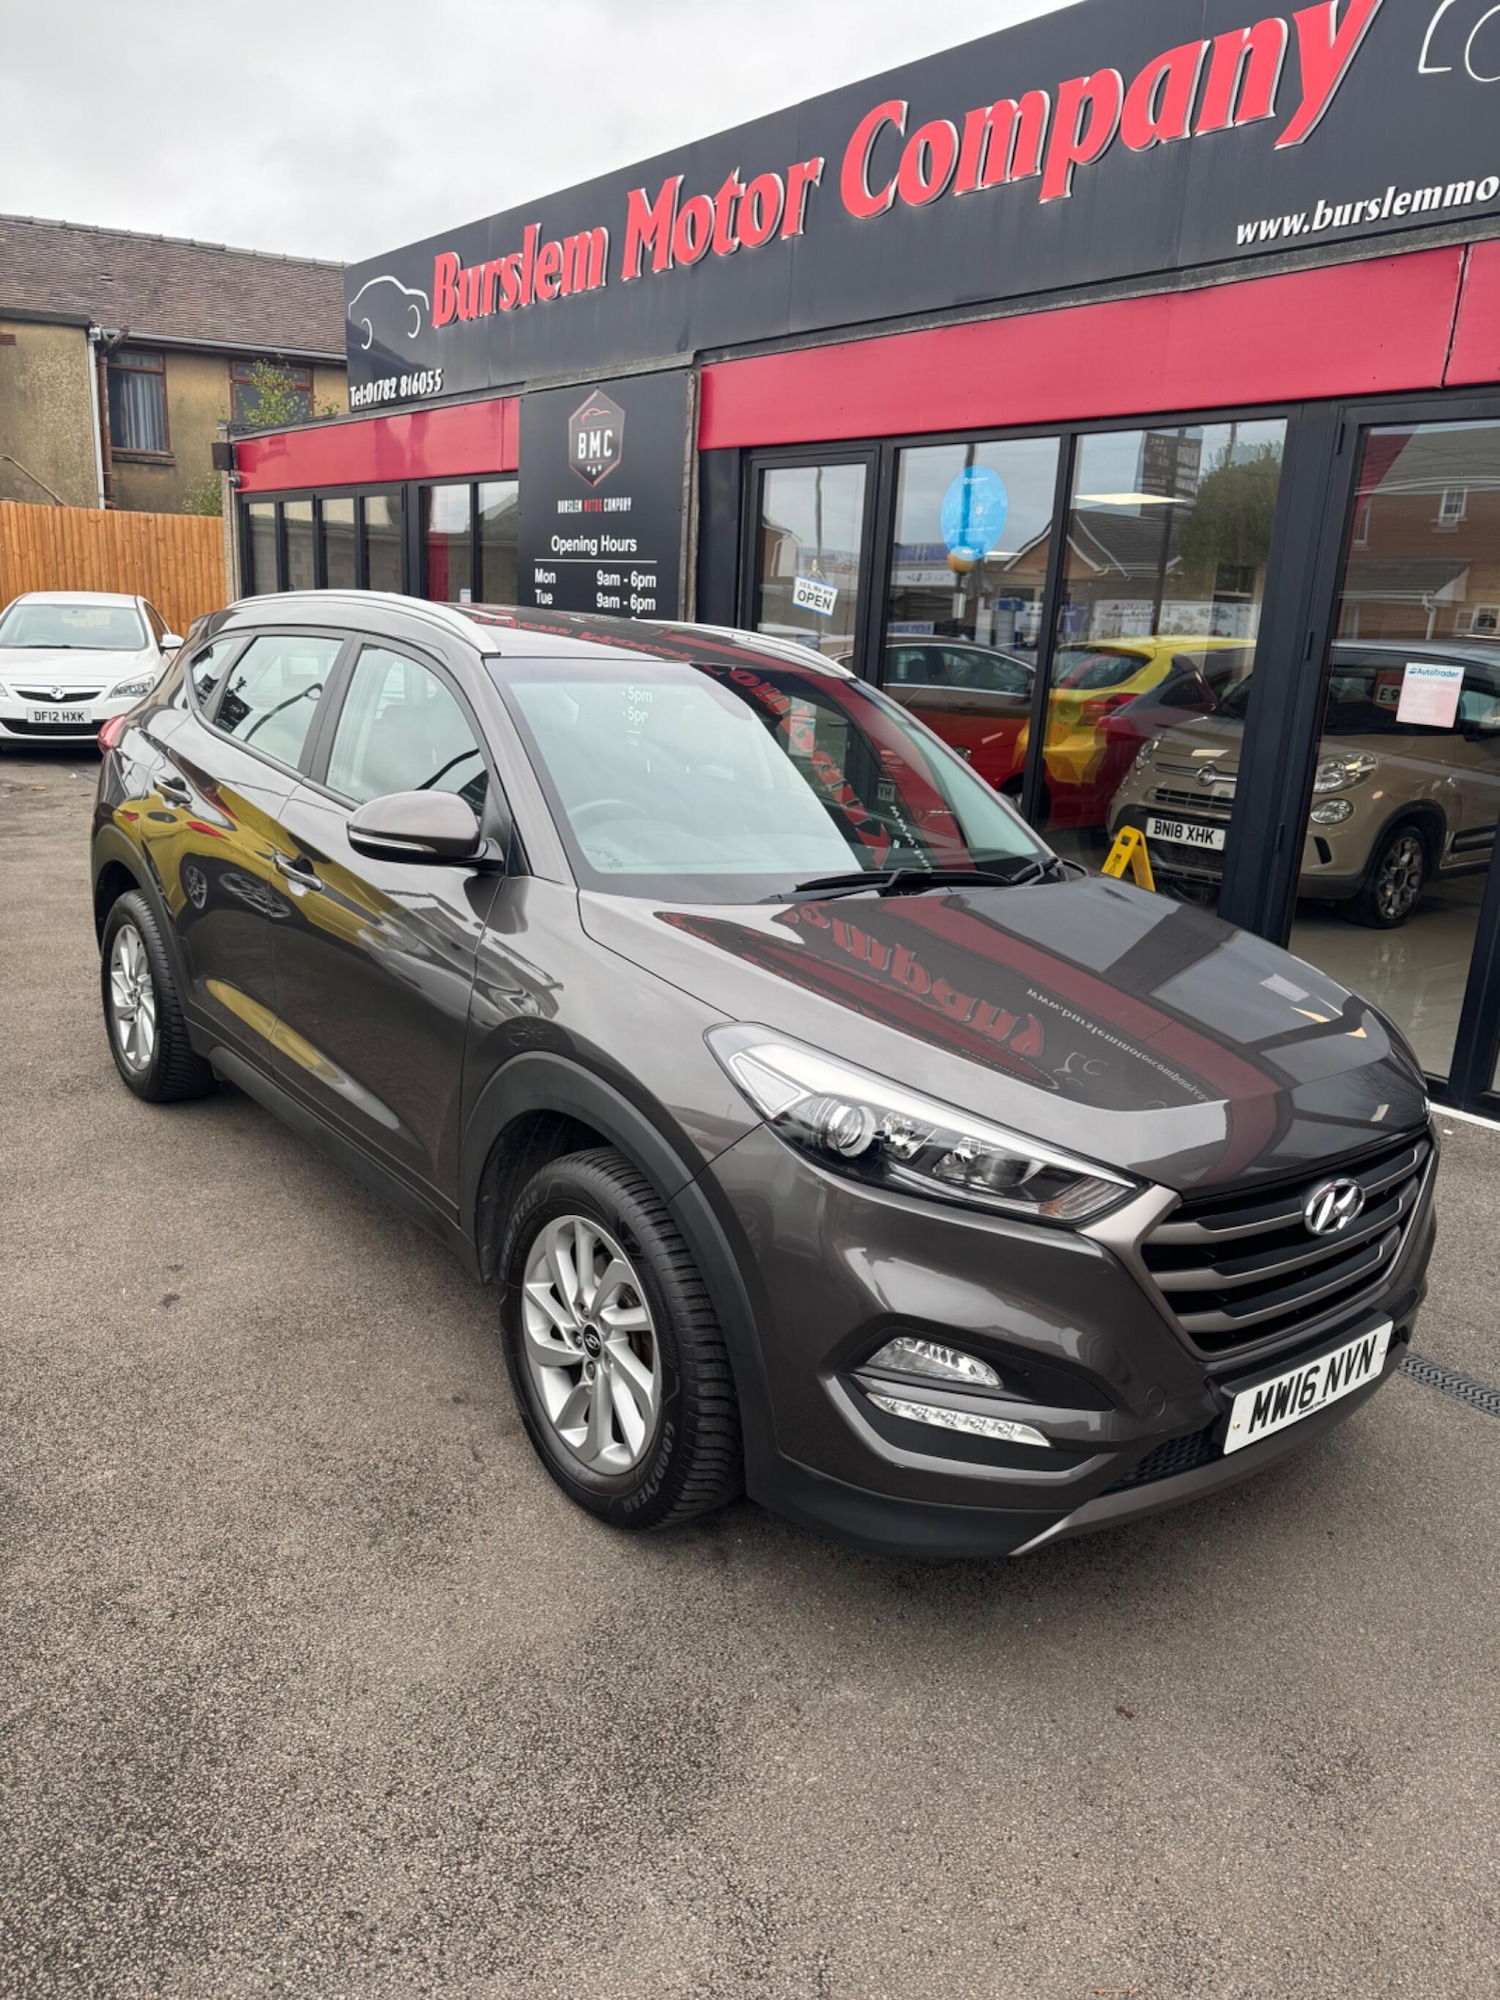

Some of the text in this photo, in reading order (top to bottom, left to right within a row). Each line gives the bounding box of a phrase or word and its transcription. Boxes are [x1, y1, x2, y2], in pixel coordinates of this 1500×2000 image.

[432, 0, 1384, 328] Burslem Motor Company
[1237, 175, 1500, 245] www.burslemmo
[350, 368, 443, 406] Tel:01782 816055
[577, 429, 613, 459] BMC
[551, 534, 638, 556] Opening Hours
[534, 568, 556, 584] Mon
[596, 569, 621, 586] 9am
[630, 571, 657, 591] 6pm
[534, 589, 553, 605] Tue
[596, 592, 620, 608] 9am
[630, 593, 656, 613] 6pm
[797, 589, 832, 610] OPEN
[1416, 667, 1460, 678] AutoTrader
[33, 711, 85, 722] DF12 HXK
[1153, 820, 1216, 845] BN18 XHK
[1247, 1333, 1378, 1435] MW16 NVN
